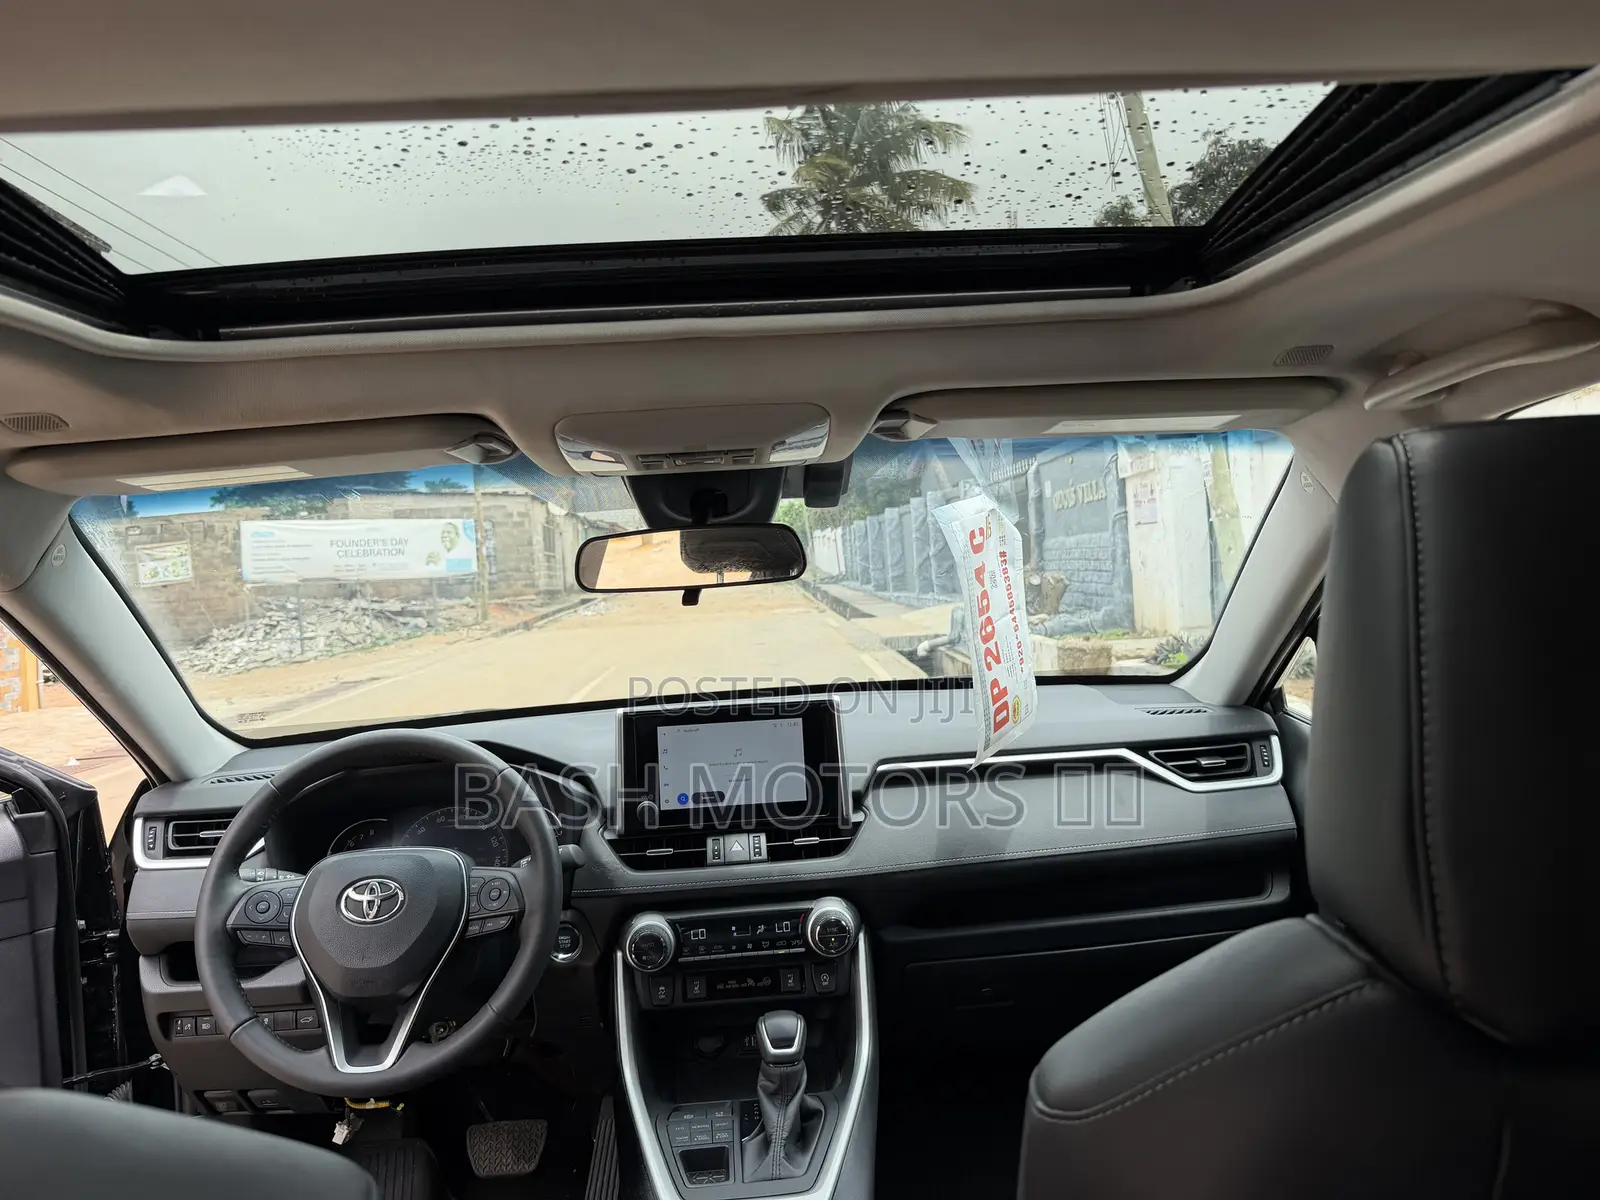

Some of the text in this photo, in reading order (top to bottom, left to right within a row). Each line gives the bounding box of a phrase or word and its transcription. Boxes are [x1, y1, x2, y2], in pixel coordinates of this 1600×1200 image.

[330, 537, 409, 549] FOUNDER'S DAY
[968, 526, 985, 554] C
[336, 546, 405, 558] CELEBRATION
[974, 560, 1002, 672] 2654
[990, 677, 1010, 734] DP
[490, 836, 499, 848] 120
[775, 921, 791, 933] LO
[691, 928, 706, 940] LO
